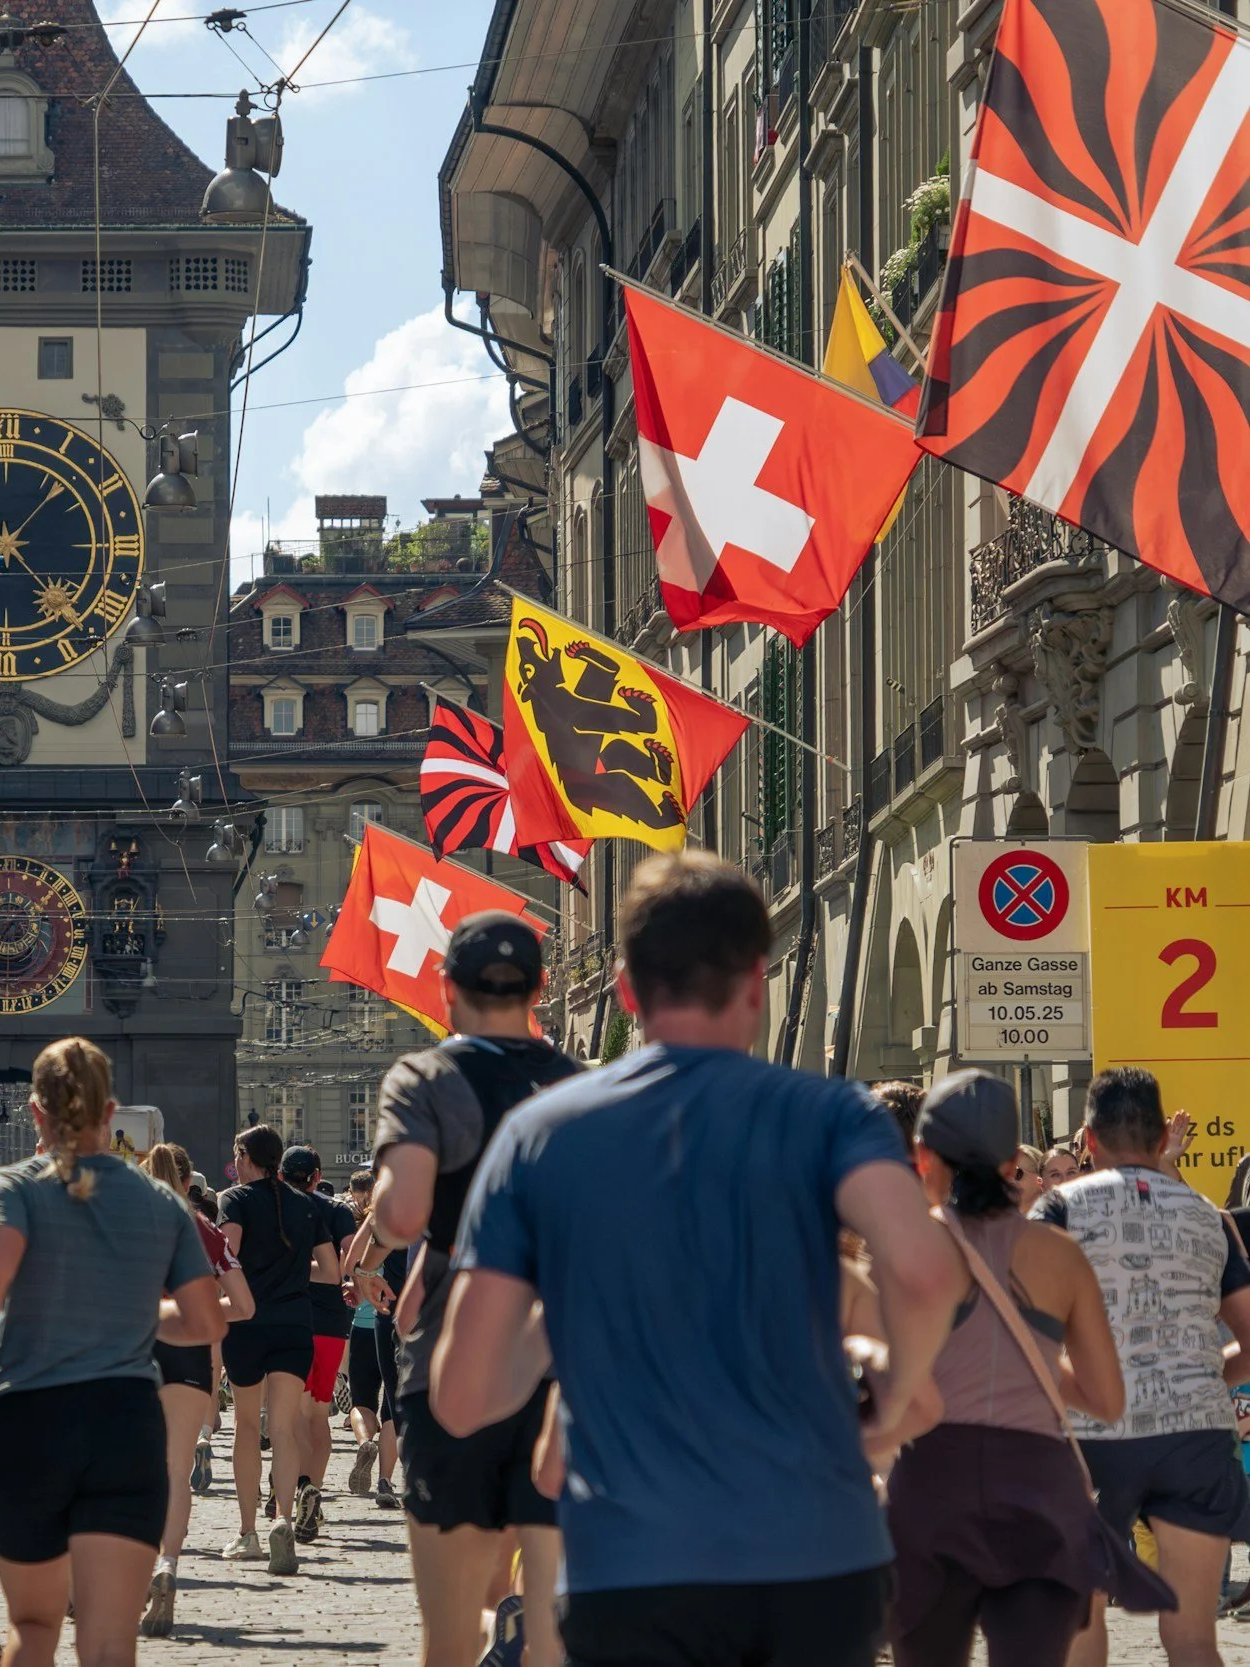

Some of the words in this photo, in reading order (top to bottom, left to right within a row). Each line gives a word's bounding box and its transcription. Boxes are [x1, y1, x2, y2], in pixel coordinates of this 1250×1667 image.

[1166, 887, 1207, 908] KM
[972, 957, 1022, 971] Ganze
[1028, 957, 1078, 971] Gasse
[978, 982, 998, 995] ab
[1004, 982, 1073, 998] Samstag
[1158, 938, 1218, 1029] 2
[988, 1006, 1064, 1020] 10.05.25
[1001, 1029, 1049, 1044] 10.00
[1207, 1116, 1235, 1136] ds
